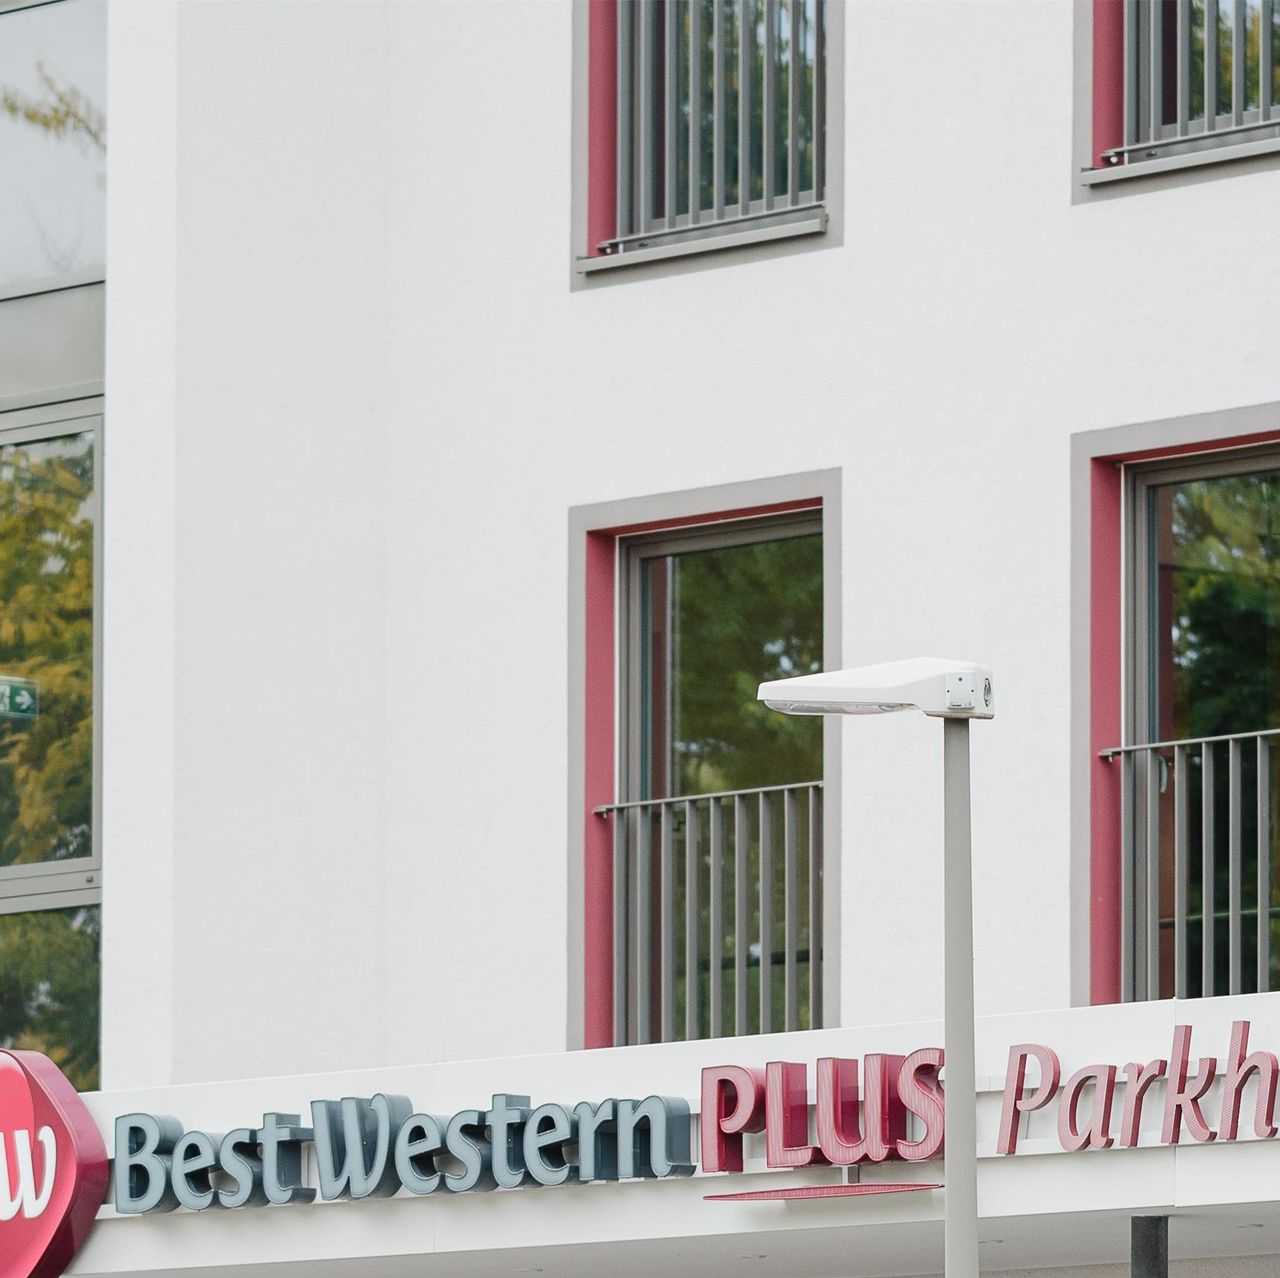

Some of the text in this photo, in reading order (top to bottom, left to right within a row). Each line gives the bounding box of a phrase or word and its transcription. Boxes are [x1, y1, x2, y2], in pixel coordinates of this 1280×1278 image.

[114, 1111, 316, 1215] Best
[311, 1092, 697, 1202] Western
[701, 1047, 945, 1173] PLUS
